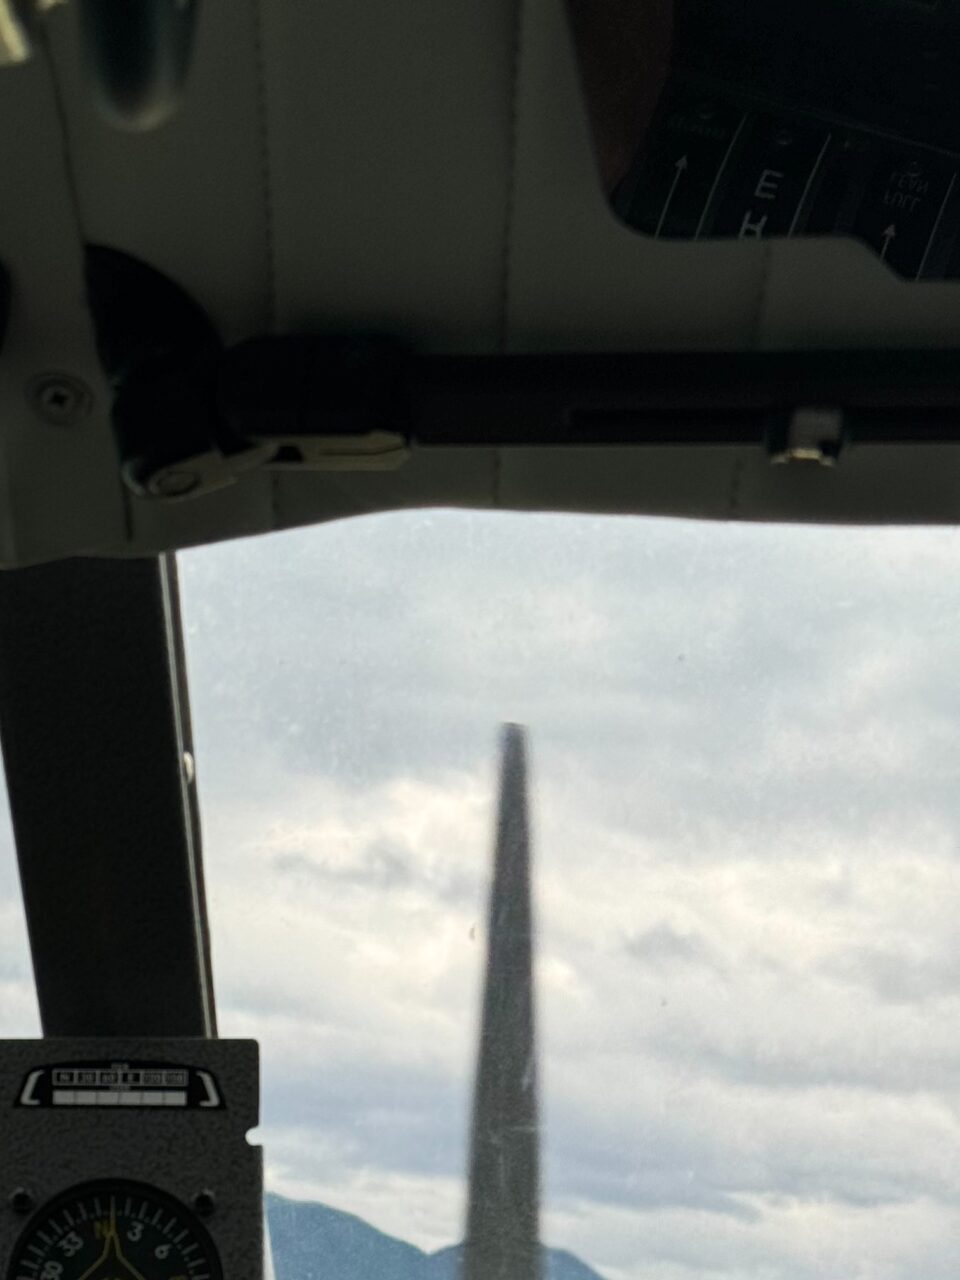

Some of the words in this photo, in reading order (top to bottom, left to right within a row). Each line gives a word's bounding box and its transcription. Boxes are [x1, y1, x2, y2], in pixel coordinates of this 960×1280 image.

[127, 1221, 144, 1242] 3
[57, 1230, 84, 1257] 33
[154, 1244, 173, 1260] 6
